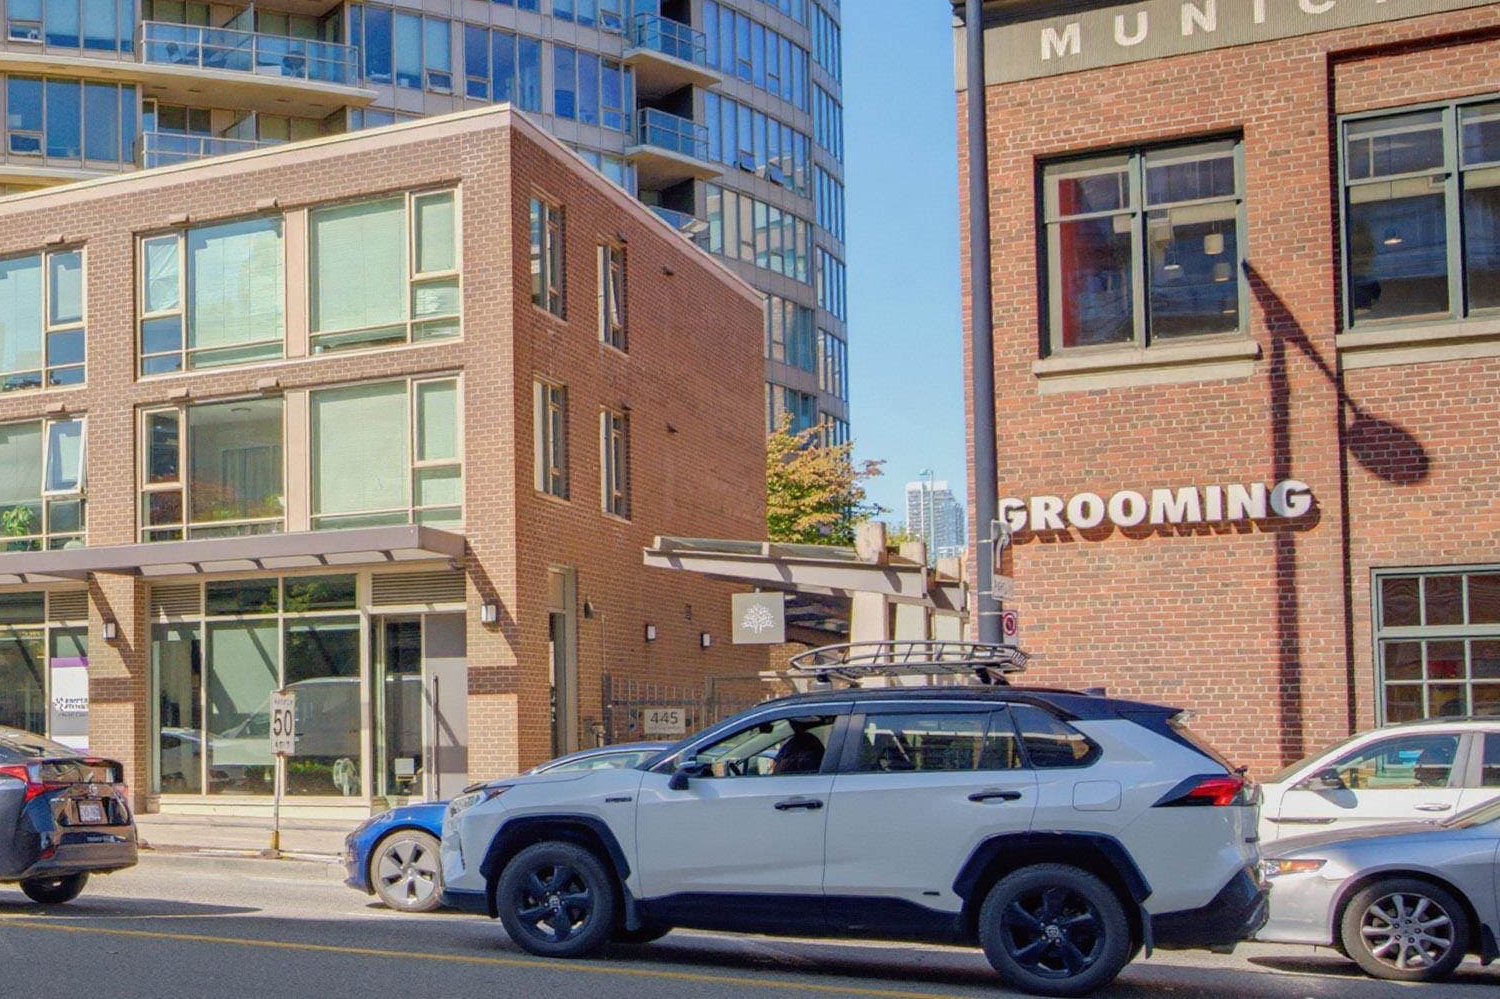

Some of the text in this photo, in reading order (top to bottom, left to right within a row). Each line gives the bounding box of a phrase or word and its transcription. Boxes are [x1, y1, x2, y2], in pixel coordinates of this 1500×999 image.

[999, 480, 1312, 532] GROOMING
[273, 708, 293, 736] 50
[650, 711, 678, 725] 445
